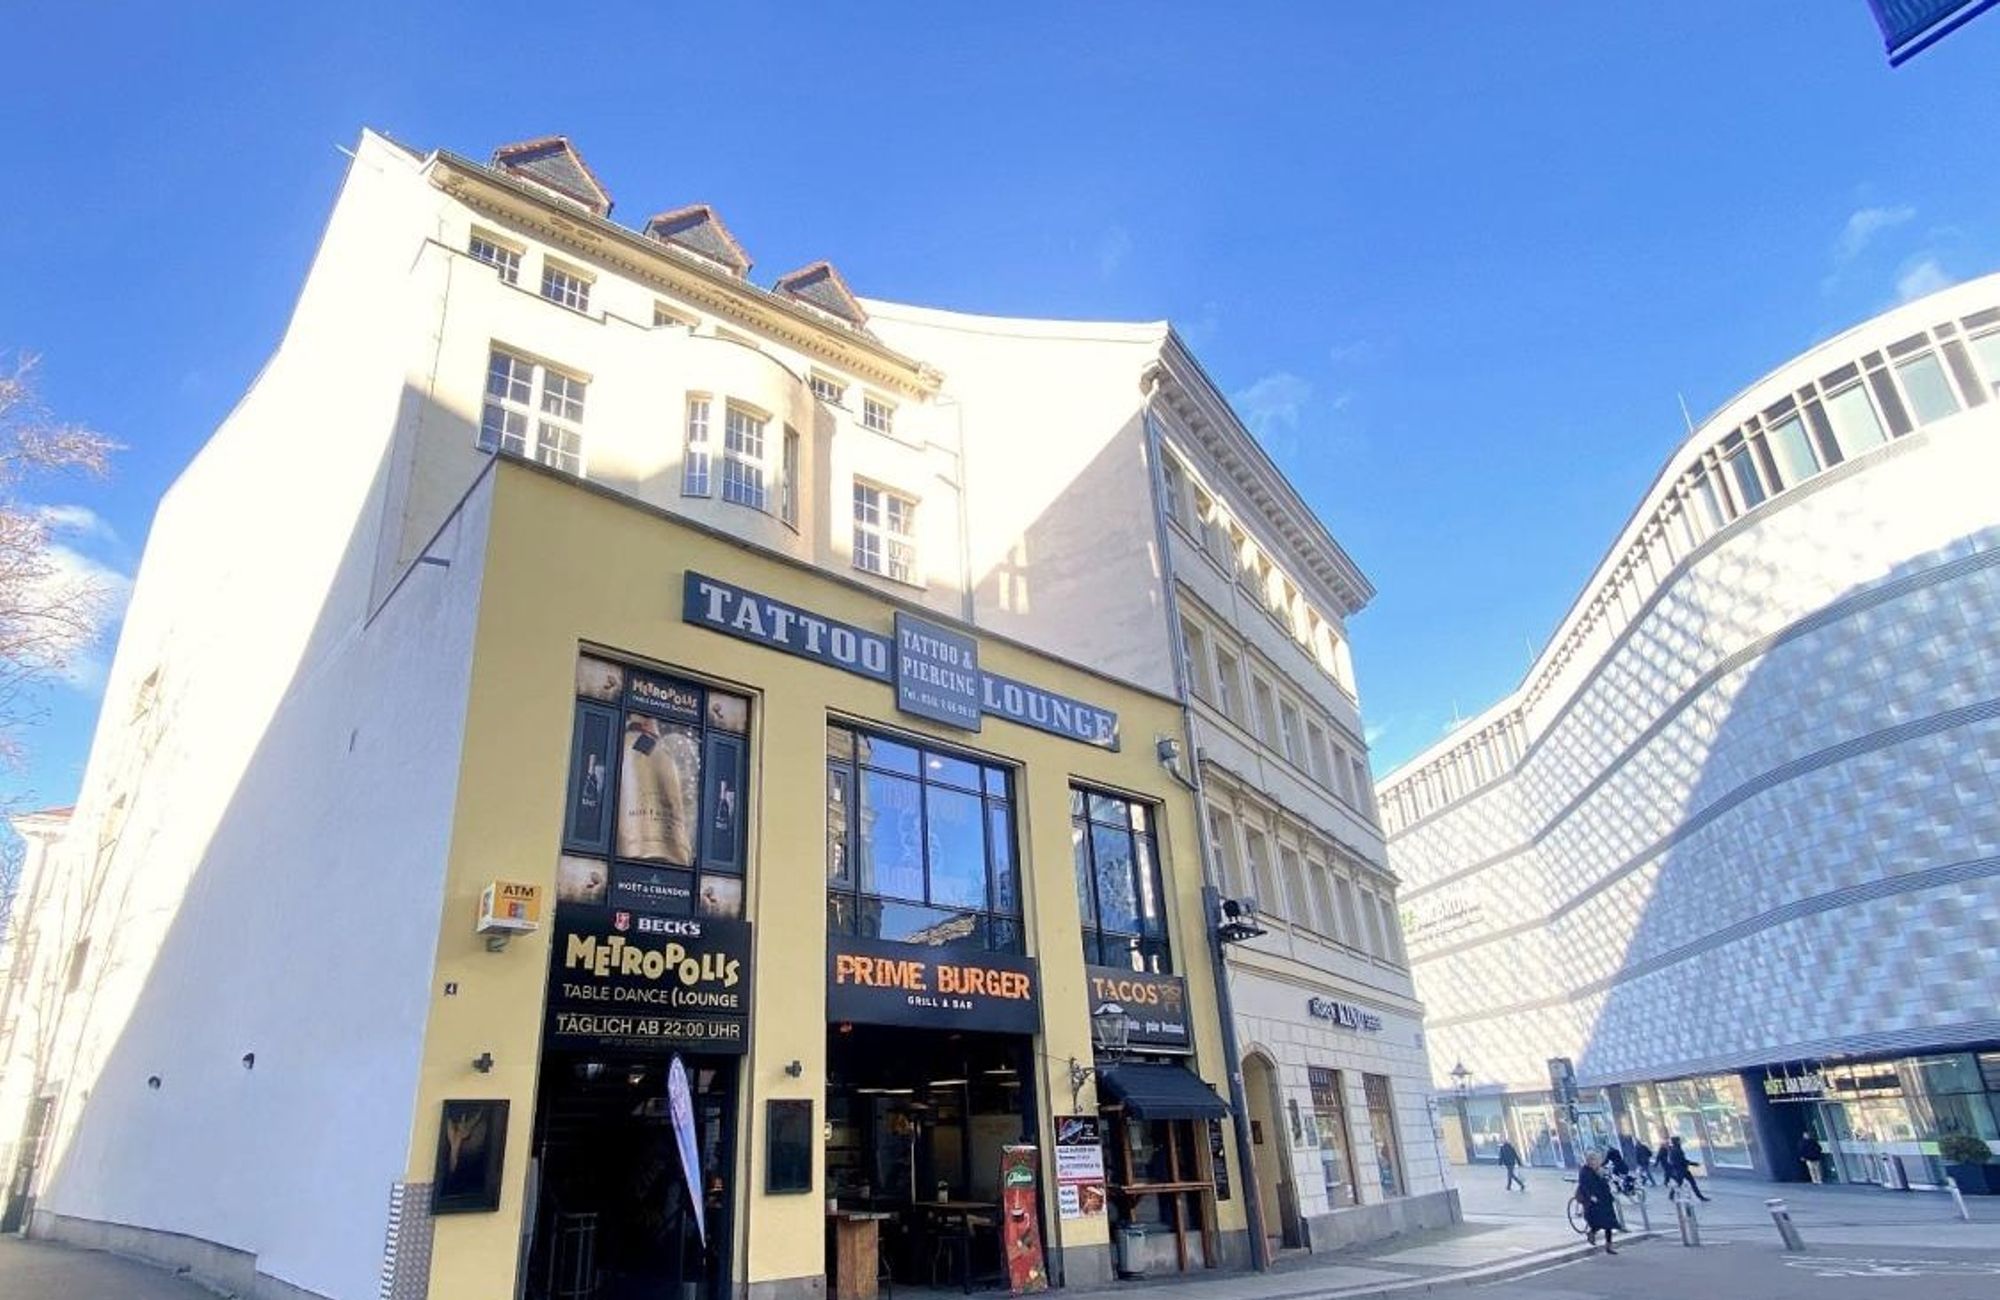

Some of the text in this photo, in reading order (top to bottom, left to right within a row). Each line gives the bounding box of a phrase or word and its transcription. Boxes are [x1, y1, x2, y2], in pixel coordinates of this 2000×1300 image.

[699, 581, 1114, 744] TATTOO LOUNGE
[901, 629, 973, 670] TATTOO &
[902, 656, 975, 697] PIERCING
[633, 678, 698, 708] METROPOLIS
[504, 884, 534, 898] ATM
[638, 917, 702, 936] BECK'S
[565, 934, 740, 988] METROPOLIS
[836, 954, 1031, 1001] PRIME BURGER
[1092, 977, 1159, 1005] TACOS
[563, 983, 611, 1001] TABLE
[614, 988, 669, 1005] DANCE
[907, 995, 938, 1008] GRILL
[952, 999, 973, 1010] BAR
[557, 1013, 740, 1039] TÄGLICH AB 22:00 UHR
